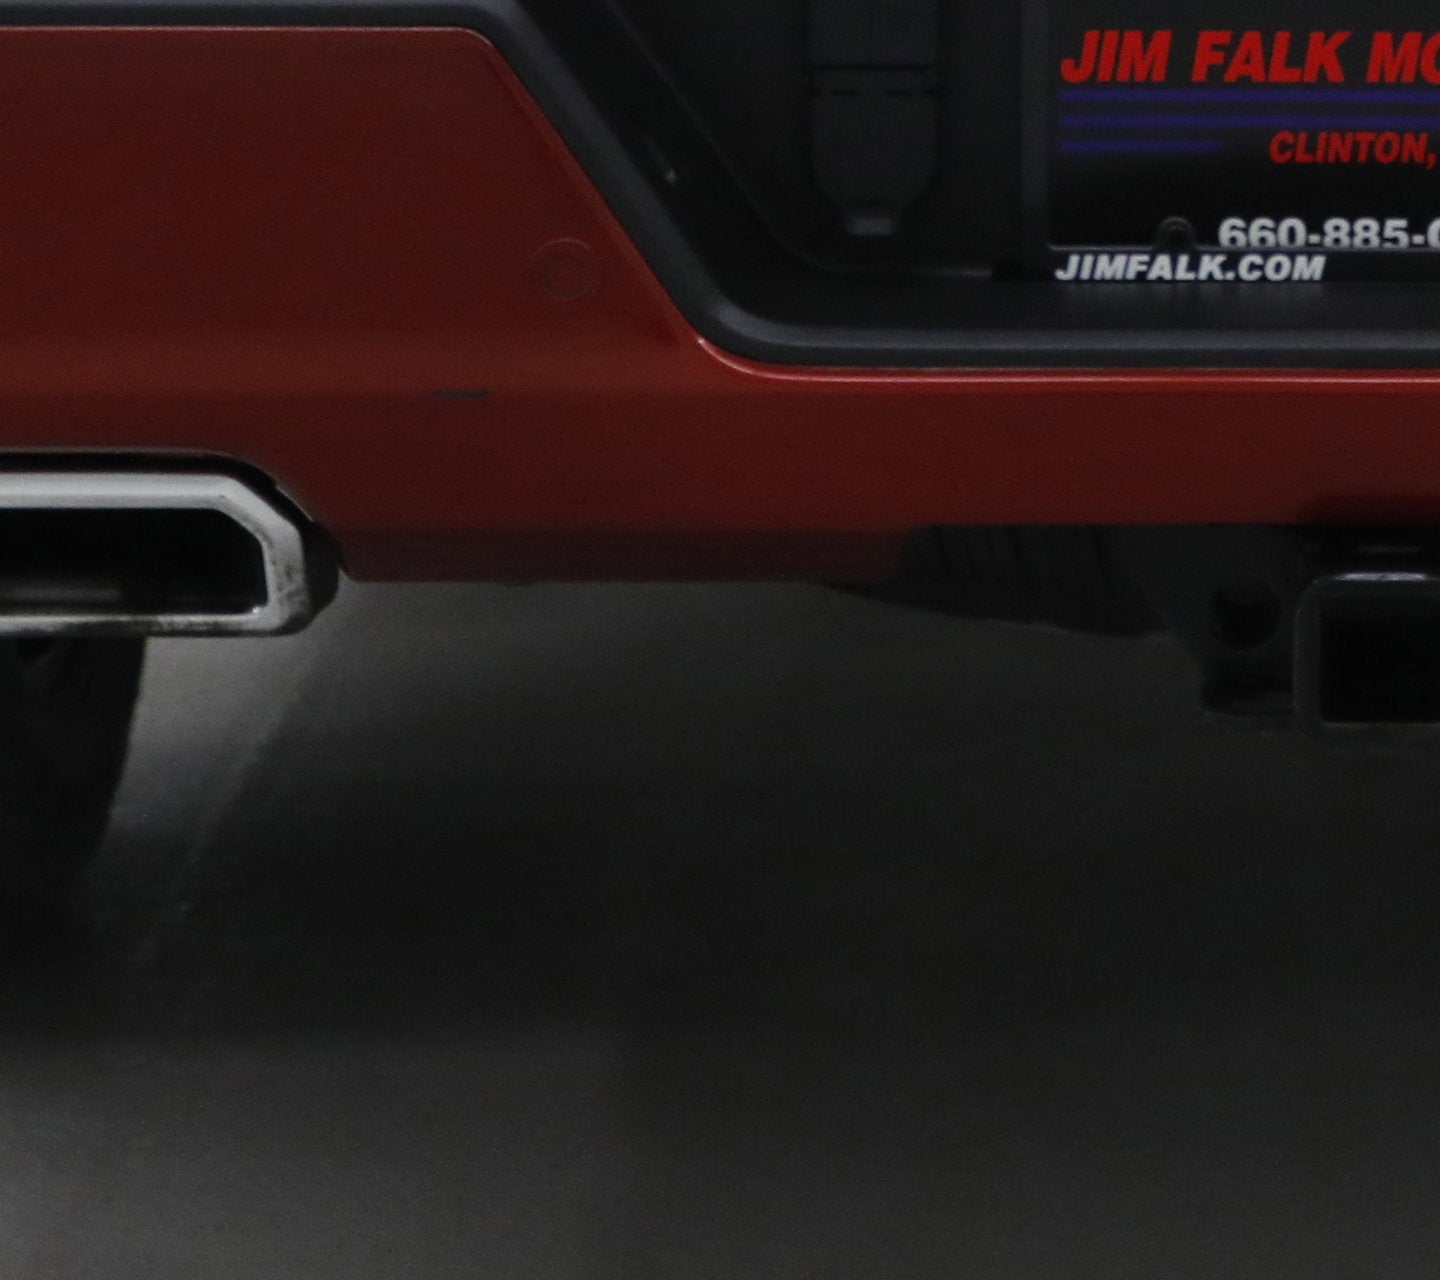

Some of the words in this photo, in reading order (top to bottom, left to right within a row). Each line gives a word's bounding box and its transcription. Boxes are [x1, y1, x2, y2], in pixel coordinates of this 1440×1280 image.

[1060, 30, 1171, 84] JIM
[1191, 31, 1352, 83] FALK
[1268, 131, 1437, 169] CLINTON,
[1055, 253, 1326, 283] JIMFALK.COM
